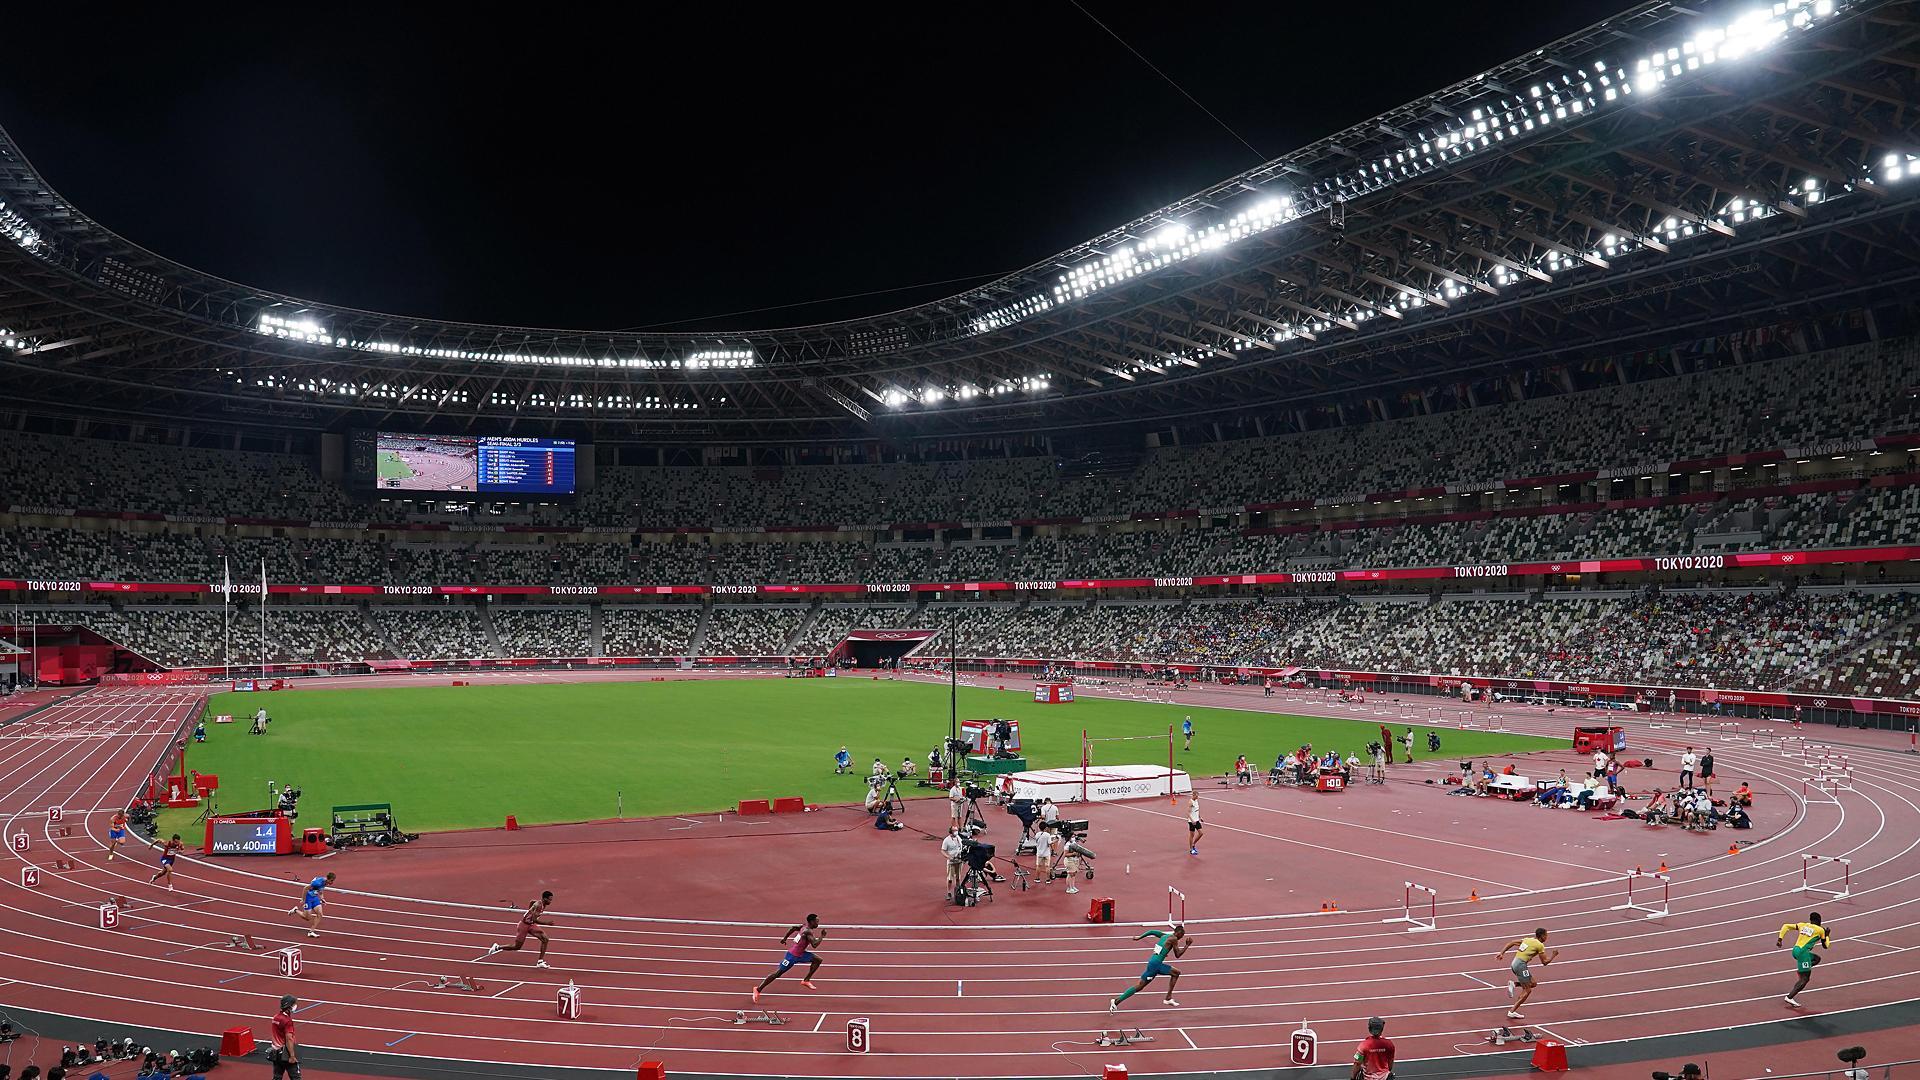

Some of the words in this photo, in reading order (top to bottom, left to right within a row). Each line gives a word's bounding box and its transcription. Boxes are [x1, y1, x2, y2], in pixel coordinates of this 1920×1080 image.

[1654, 558, 1692, 570] TOKYO
[1694, 556, 1723, 569] 2020
[1292, 573, 1316, 582] TOKYO
[1317, 572, 1336, 582] 2020
[1454, 566, 1483, 578] TOKYO
[1485, 565, 1507, 576] 2020
[27, 581, 56, 590] TOKYO
[59, 582, 80, 590] 2020
[1154, 578, 1175, 586] TOKYO
[1176, 578, 1193, 586] 2020
[240, 585, 260, 593] 2020
[51, 809, 58, 818] 2
[256, 826, 272, 836] 1.4
[18, 837, 25, 848] 3
[213, 841, 240, 850] Men's
[242, 840, 276, 850] 400mH
[26, 873, 35, 883] 4
[106, 911, 114, 924] 5
[281, 956, 287, 970] 6
[293, 955, 299, 970] 6
[560, 997, 569, 1014] 7
[852, 1028, 862, 1047] 8
[1298, 1040, 1309, 1059] 9
